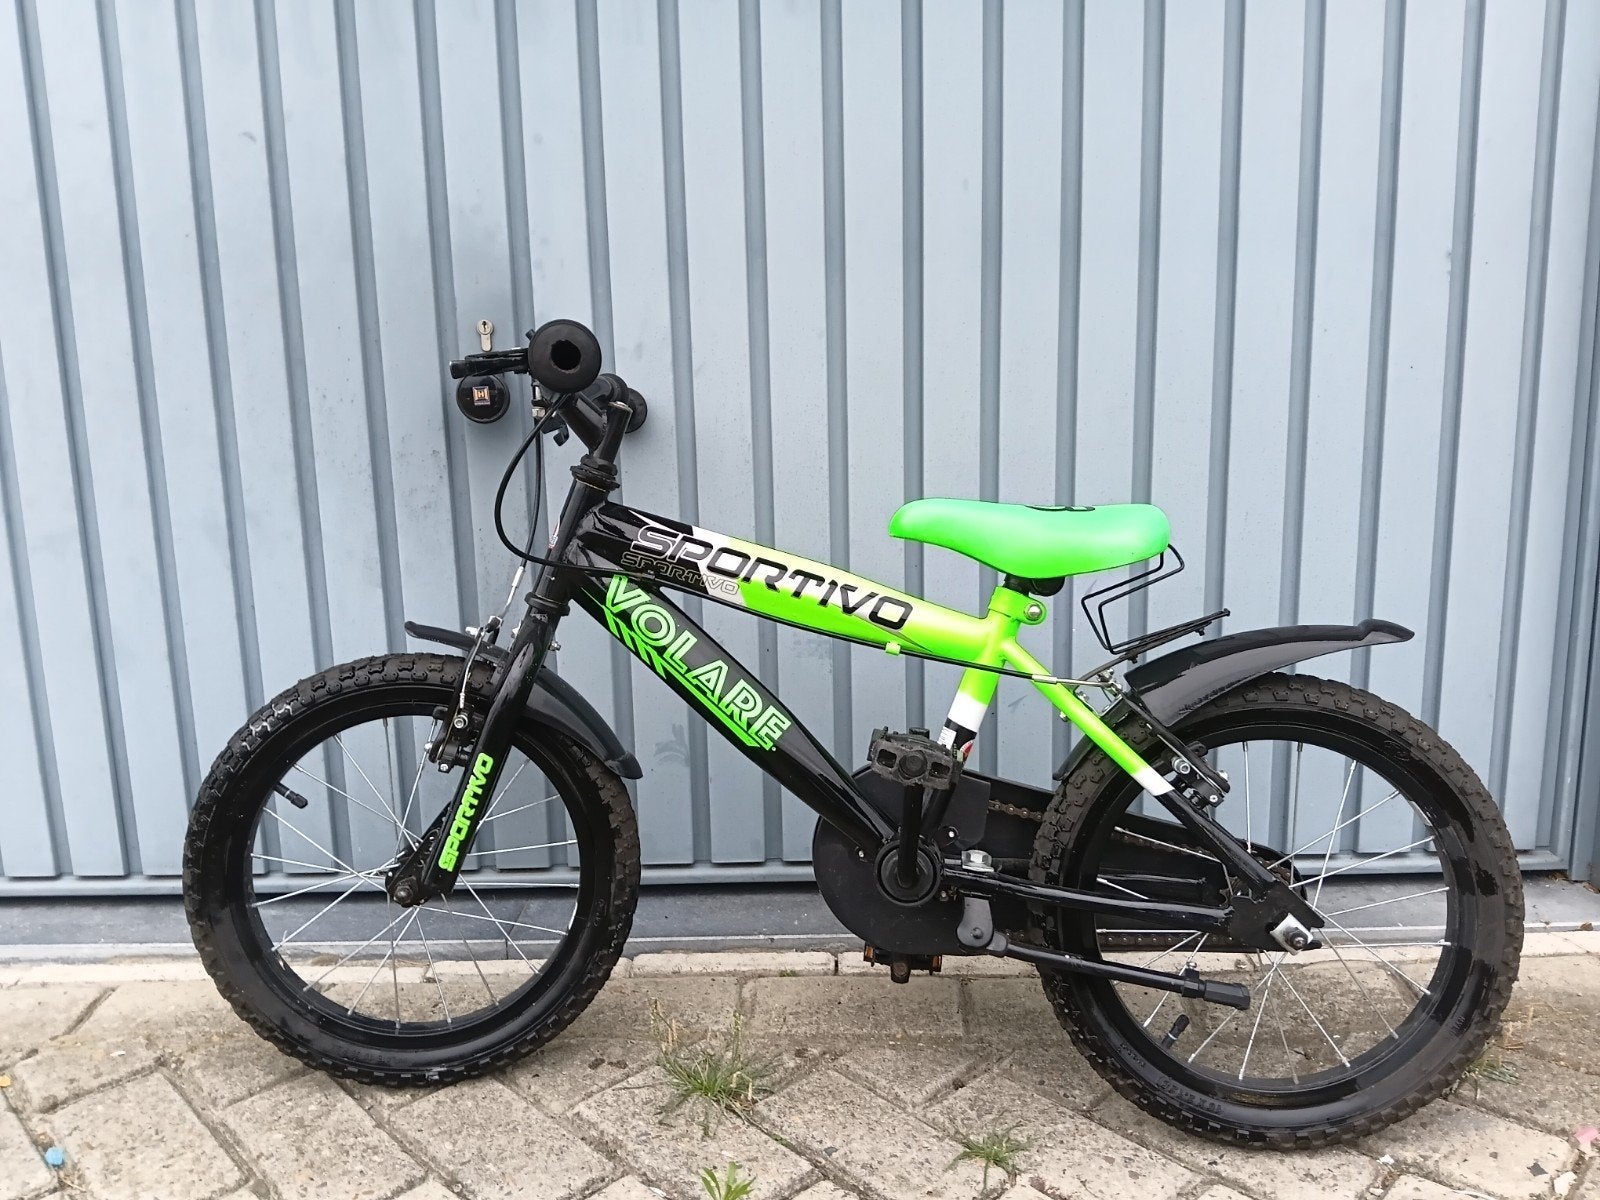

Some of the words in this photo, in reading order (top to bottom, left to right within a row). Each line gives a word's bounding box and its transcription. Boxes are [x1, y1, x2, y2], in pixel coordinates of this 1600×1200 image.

[620, 551, 740, 596] SPORTIVO
[631, 524, 914, 630] SPORTIVO
[606, 574, 792, 751] VOLARE
[438, 752, 494, 872] SPORTIVO
